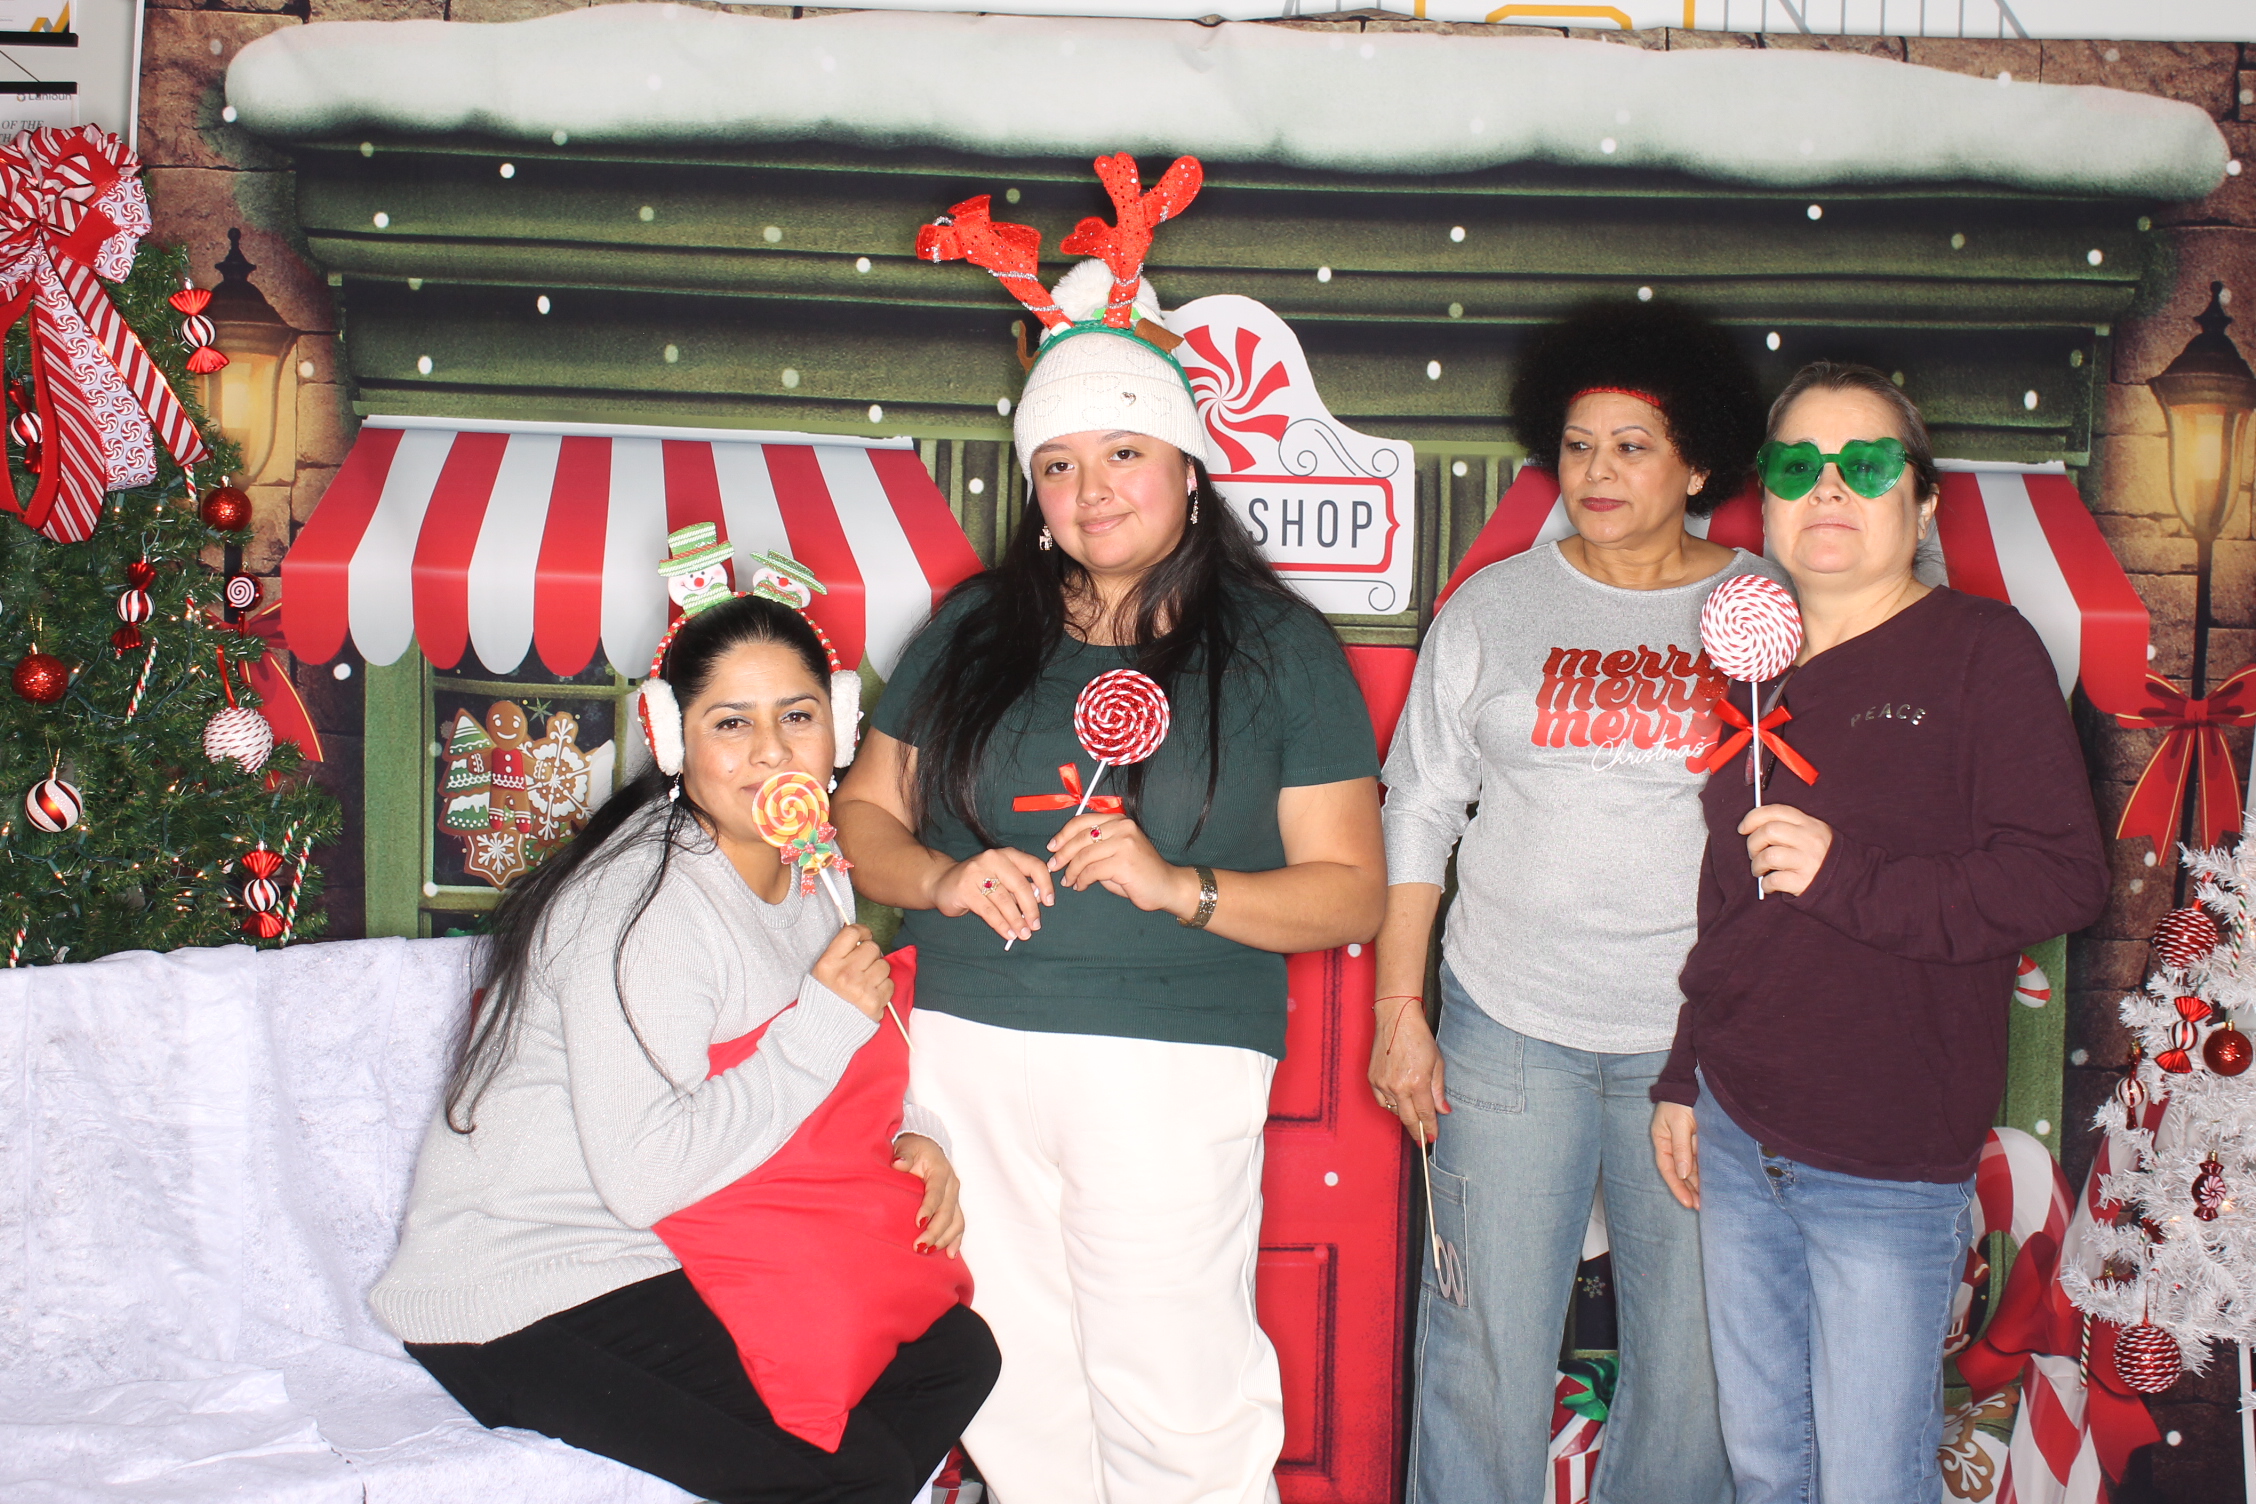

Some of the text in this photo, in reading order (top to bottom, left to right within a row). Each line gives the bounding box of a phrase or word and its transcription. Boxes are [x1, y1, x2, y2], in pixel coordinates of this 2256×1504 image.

[1, 120, 18, 130] OF
[1248, 497, 1373, 549] SHOP
[1850, 702, 1926, 727] PEACE
[1591, 734, 1718, 772] Christmas
